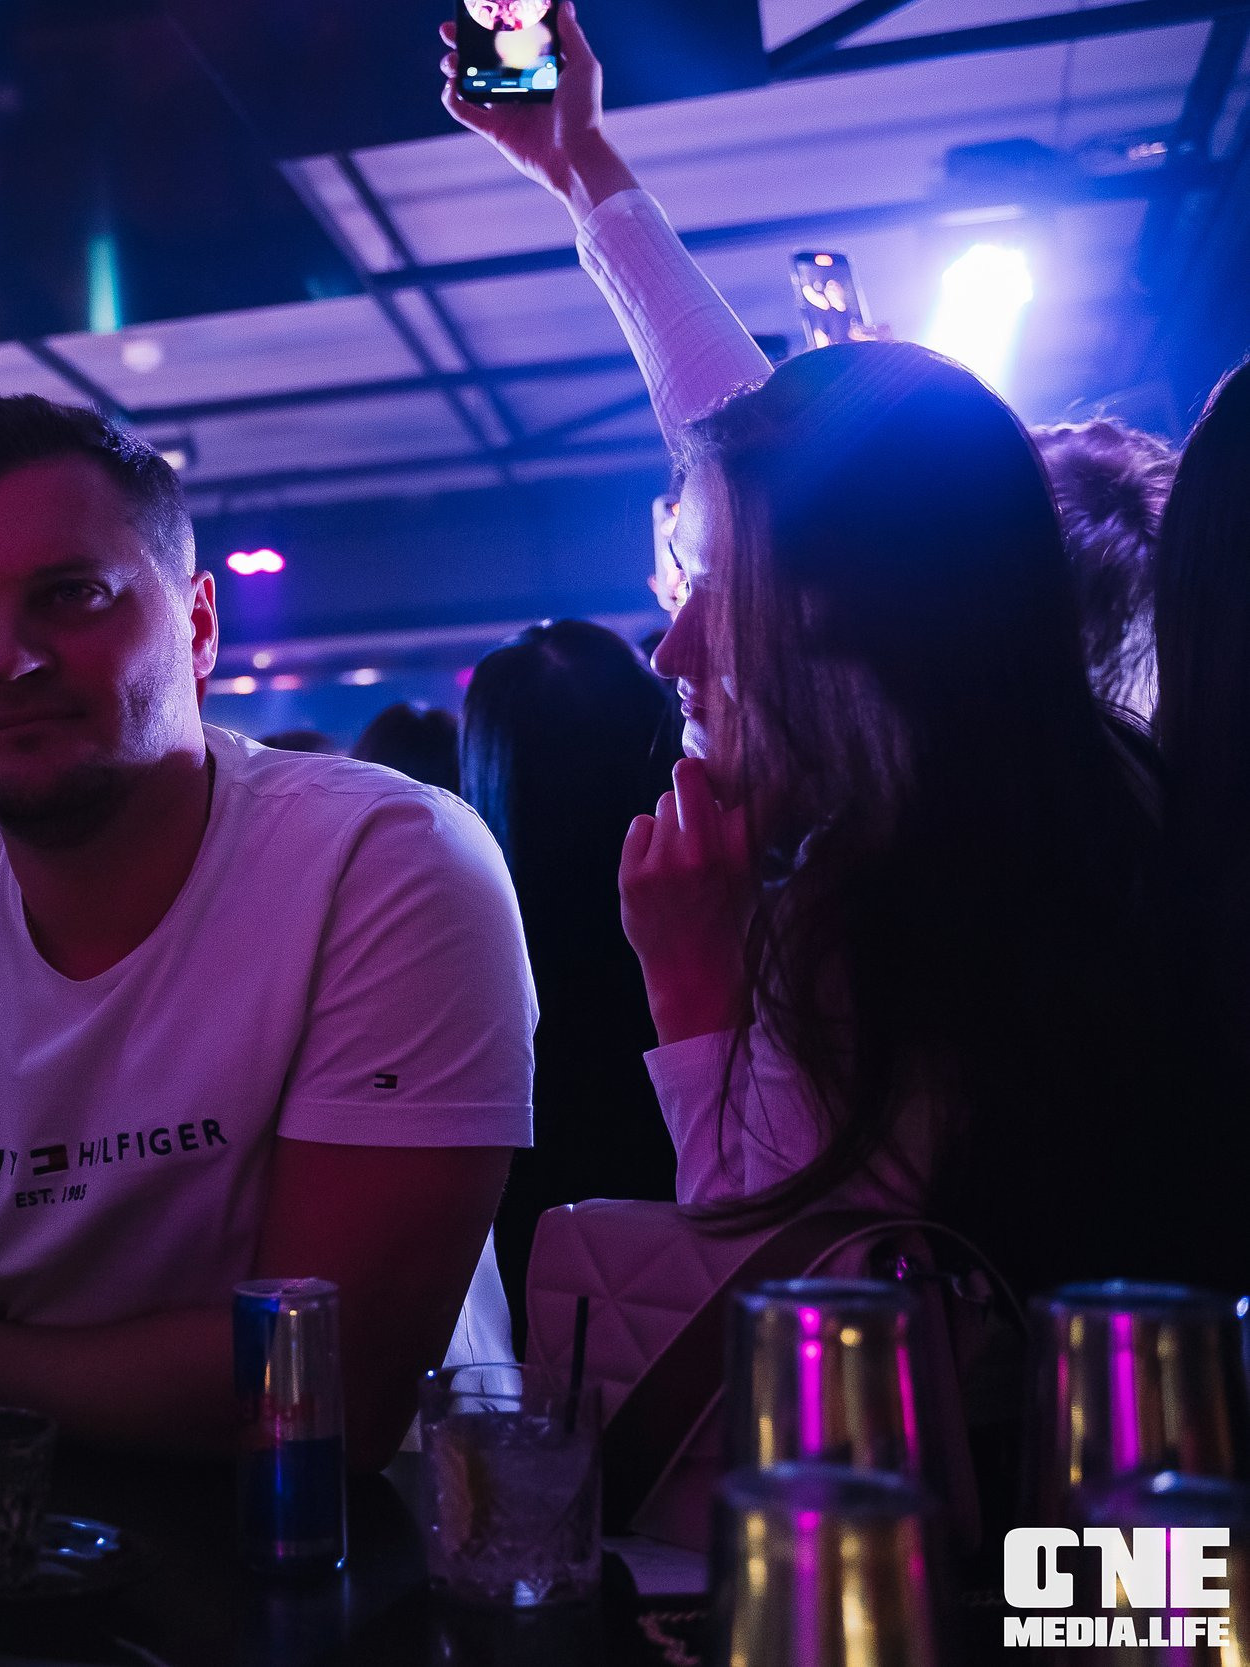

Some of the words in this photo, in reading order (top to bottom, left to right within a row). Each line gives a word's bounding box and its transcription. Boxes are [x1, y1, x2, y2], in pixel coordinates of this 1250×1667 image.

[78, 1118, 228, 1167] HILFIGER
[15, 1188, 56, 1209] EST.
[61, 1183, 88, 1203] 1985
